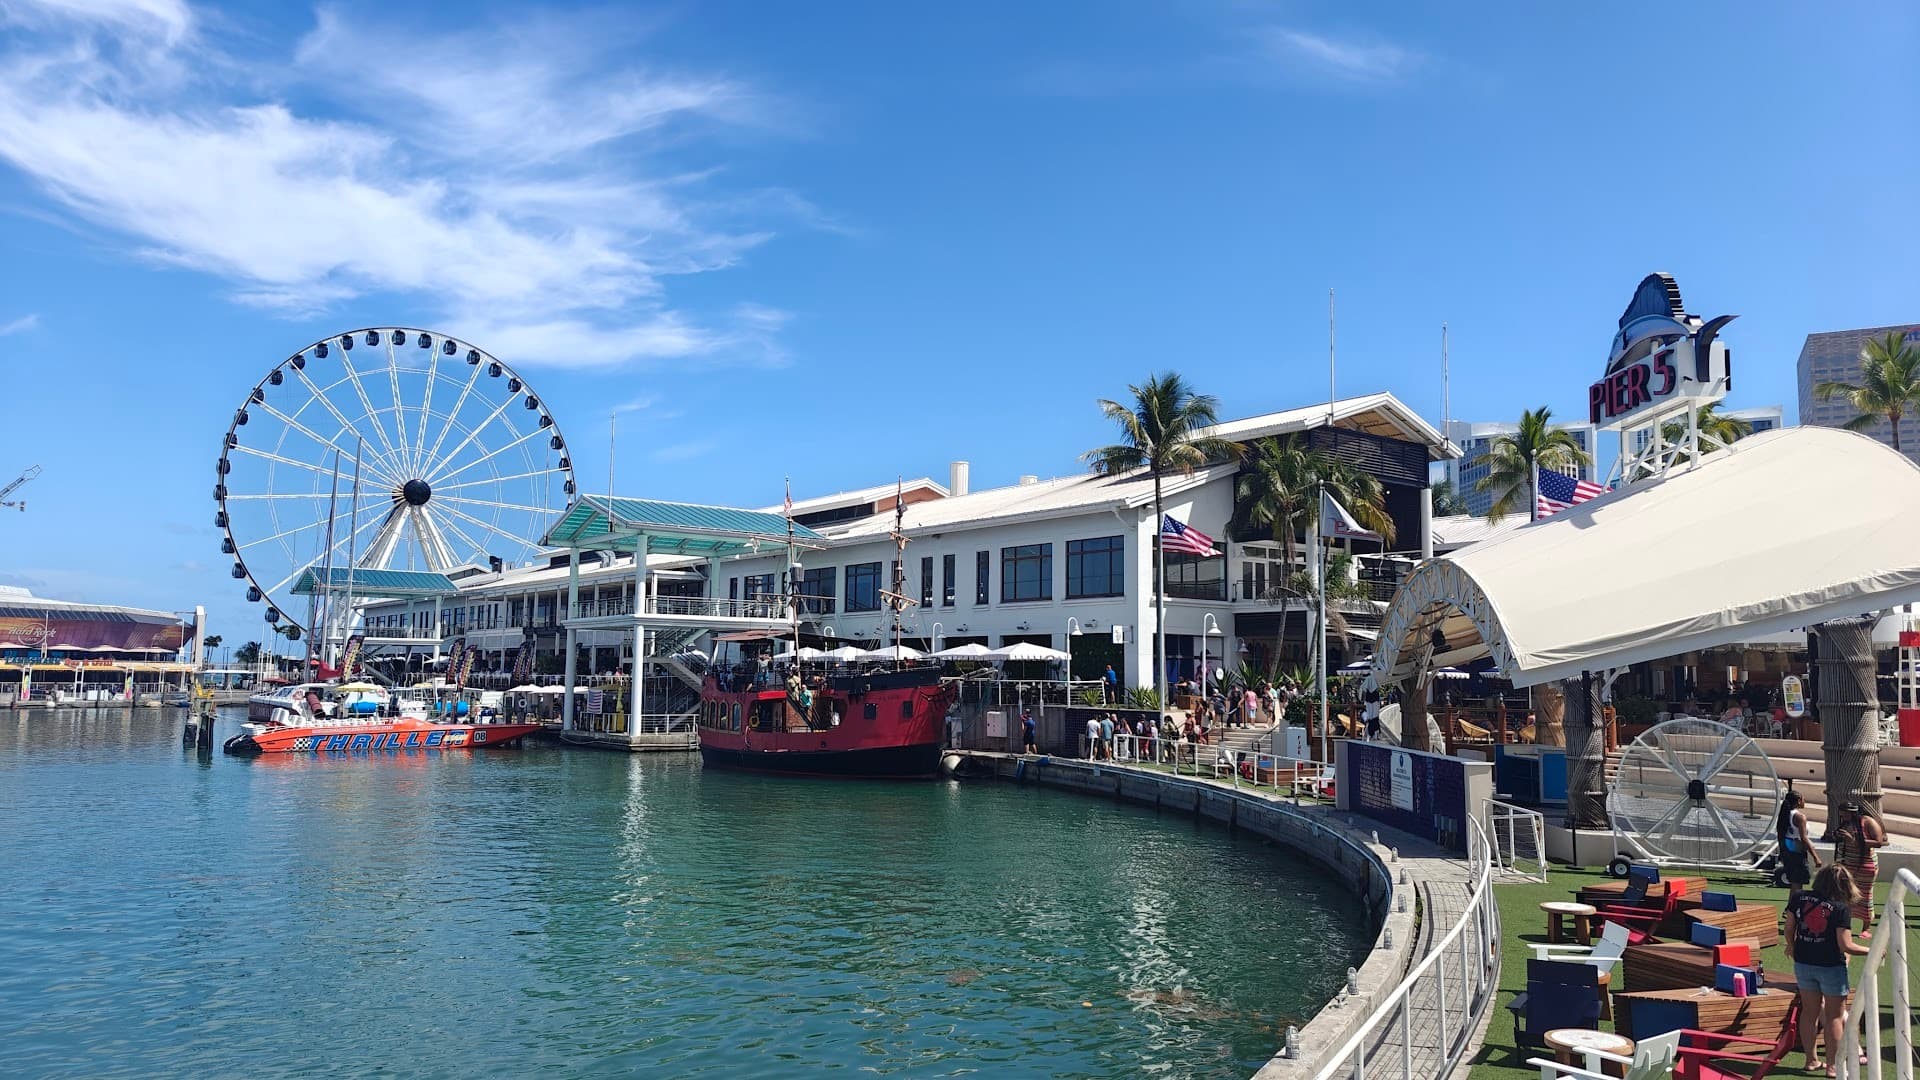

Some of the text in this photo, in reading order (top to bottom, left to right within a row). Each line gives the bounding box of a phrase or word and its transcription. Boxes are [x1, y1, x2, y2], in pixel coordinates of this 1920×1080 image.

[1589, 349, 1677, 424] PIER 5
[8, 626, 57, 638] Hard Rock
[308, 730, 467, 751] THRILLER
